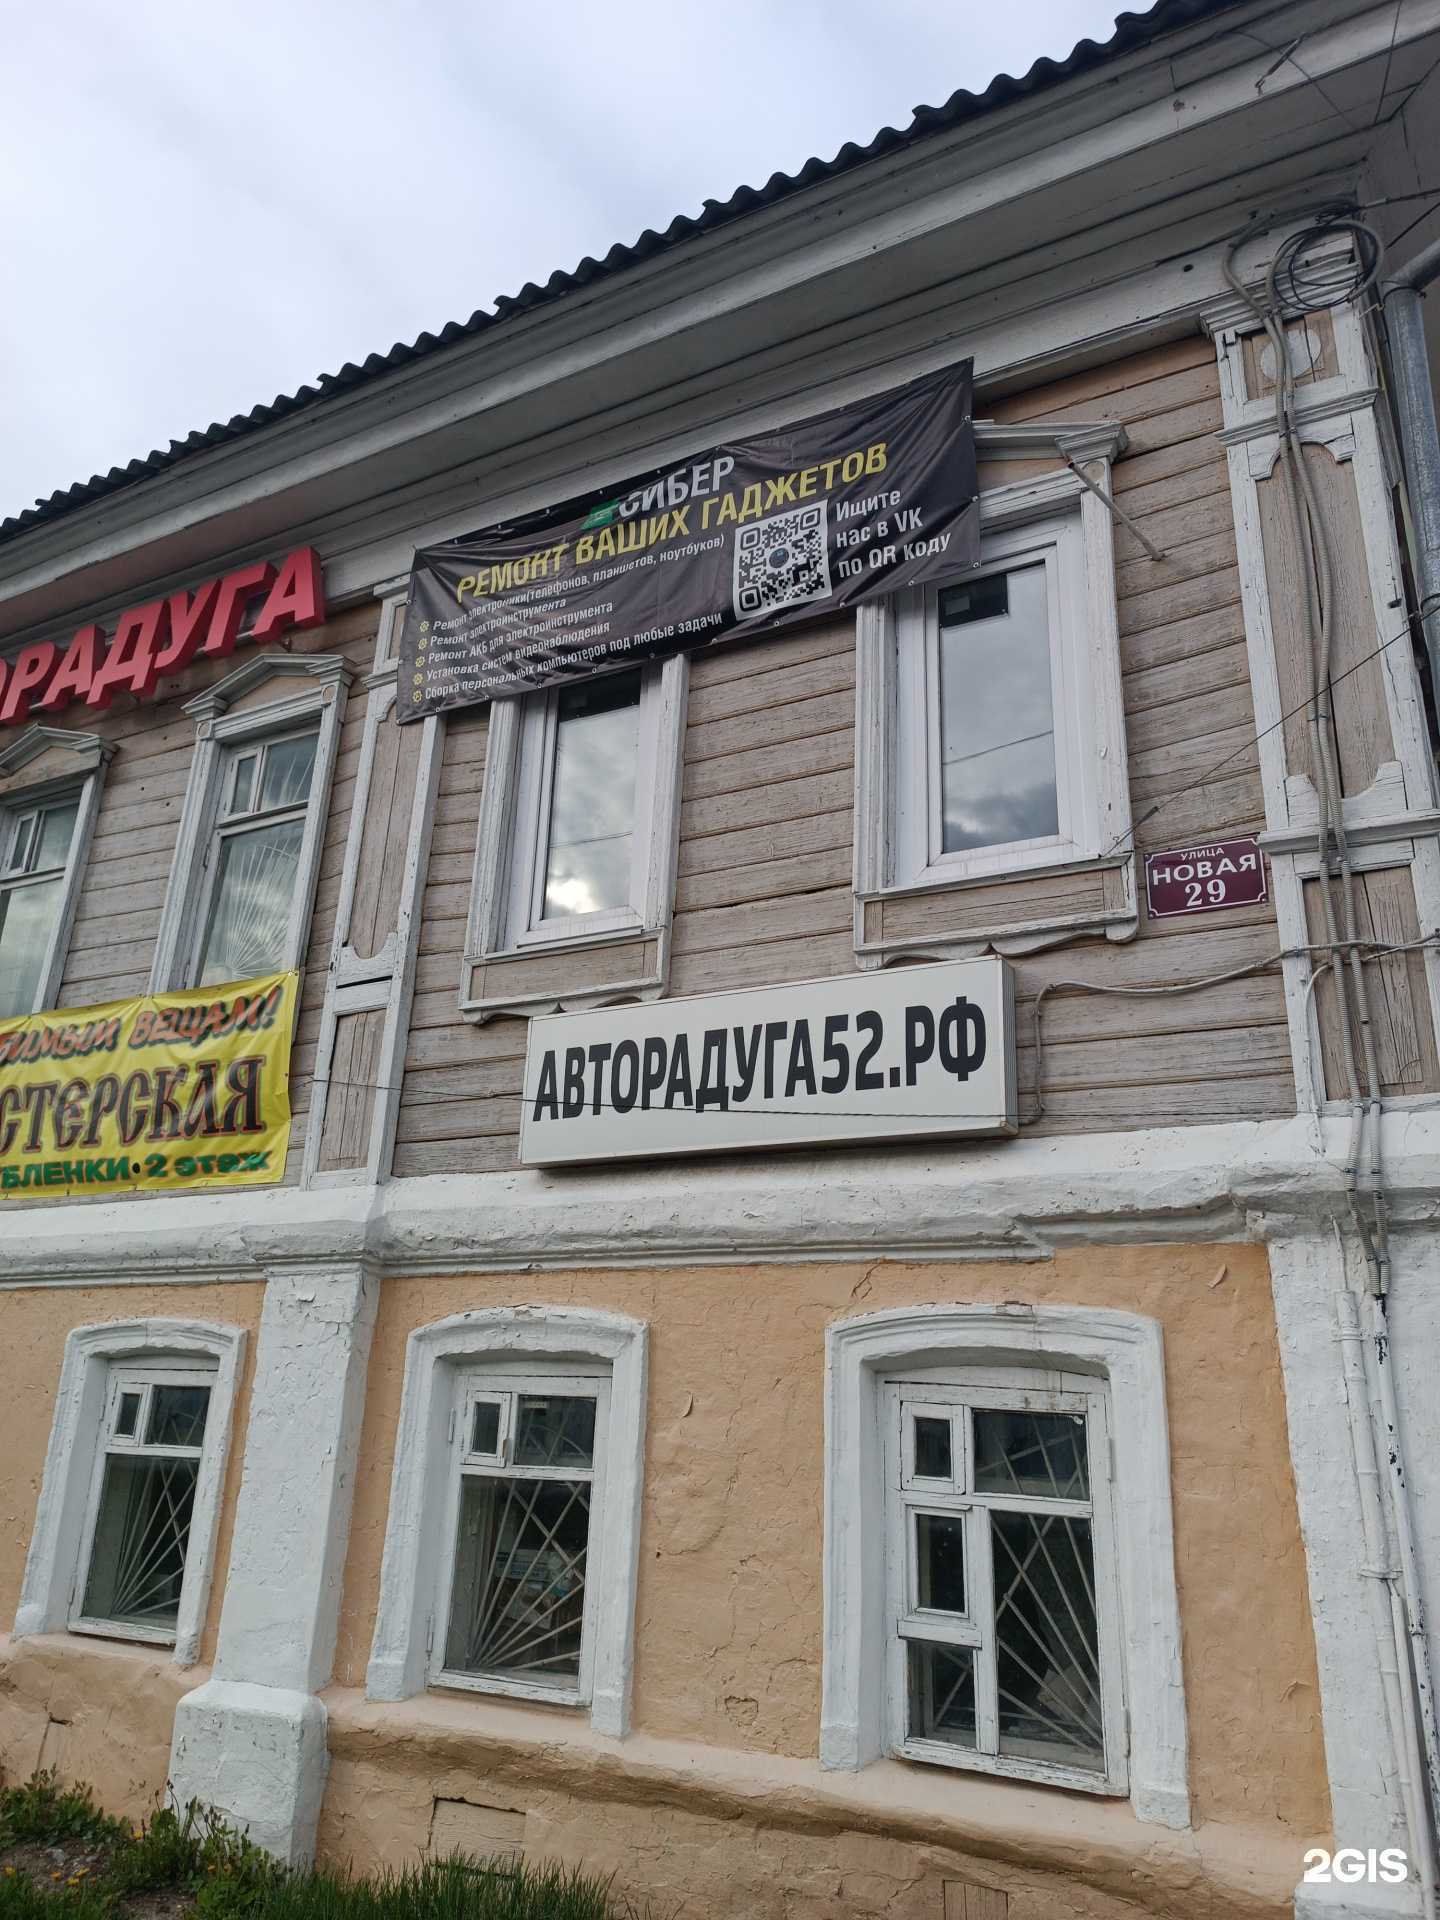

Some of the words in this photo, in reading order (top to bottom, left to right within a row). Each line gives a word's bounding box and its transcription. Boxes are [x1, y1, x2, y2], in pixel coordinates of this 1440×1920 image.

[456, 543, 570, 604] РЕМОНТ
[575, 504, 693, 566] ВАШИХ
[701, 443, 888, 530] ГАДЖЕТОВ
[835, 489, 901, 522] Ищите
[836, 526, 871, 549] нас
[877, 518, 889, 537] в
[894, 508, 923, 534] VK
[433, 612, 468, 631] Ремонт
[593, 554, 657, 582] планшетов,
[660, 533, 725, 563] ноутбуков)
[838, 560, 862, 579] по
[868, 545, 897, 570] QR
[903, 532, 952, 562] коду
[0, 546, 324, 725] РАДУГА
[426, 663, 479, 681] Установка
[481, 651, 513, 671] систем
[515, 621, 611, 660] видеонаблюдения
[428, 650, 467, 664] Ремонт
[469, 641, 488, 658] АКБ
[489, 635, 504, 653] для
[506, 601, 613, 642] электроинструмента
[430, 632, 468, 647] Ремонт
[470, 598, 567, 640] электроинструмента
[425, 681, 460, 700] Сборка
[462, 664, 534, 691] персональных
[537, 643, 607, 673] компьютеров
[610, 636, 631, 652] под
[634, 625, 674, 647] любые
[678, 613, 723, 635] задачи
[1152, 853, 1257, 886] НОВАЯ
[1180, 847, 1225, 861] УЛИЦА
[1184, 879, 1226, 907] 29
[128, 985, 283, 1048] ВЕЩАМ!
[532, 996, 987, 1122] АВТОРАДУГА52.РФ
[0, 1055, 267, 1158] СТЕРСКАЯ
[144, 1153, 169, 1178] 2
